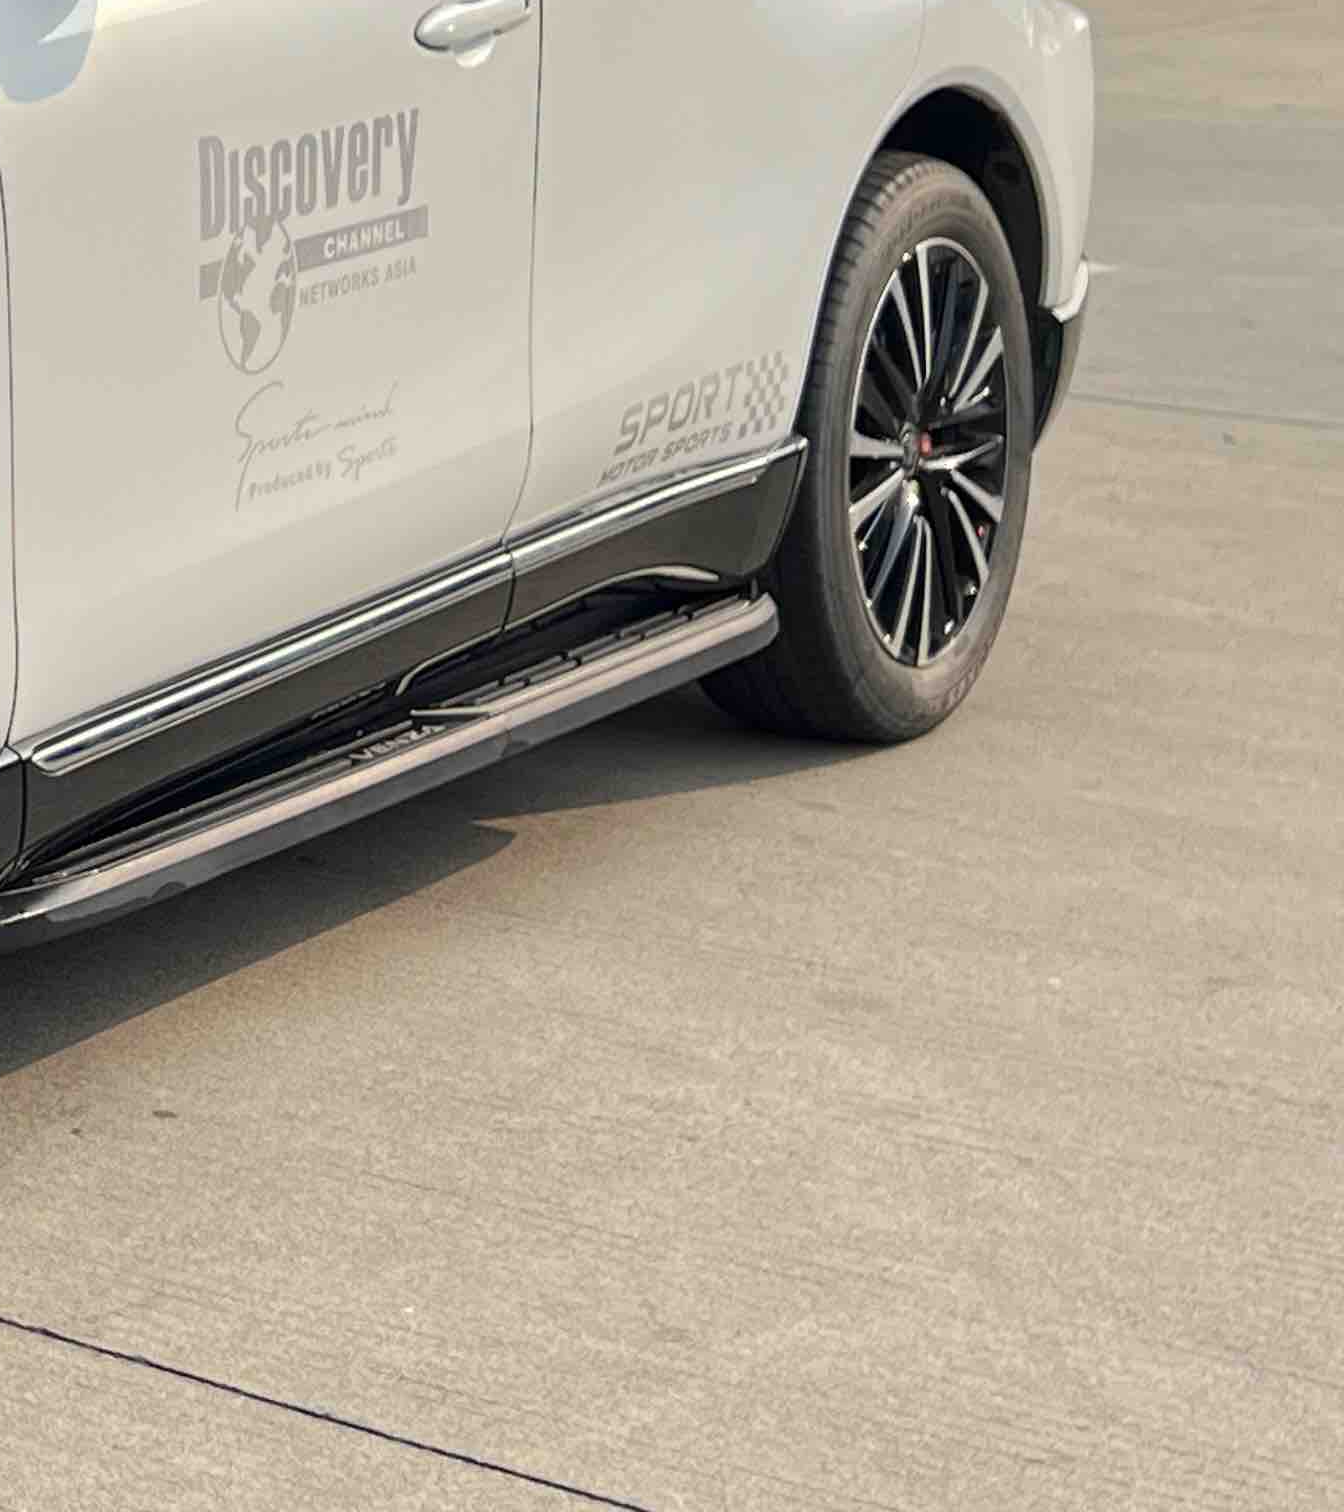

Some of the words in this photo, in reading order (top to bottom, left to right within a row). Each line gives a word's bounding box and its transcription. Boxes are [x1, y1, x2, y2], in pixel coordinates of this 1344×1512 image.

[198, 107, 419, 240] Discovery
[323, 220, 405, 259] CHANNEL
[299, 268, 380, 305] NETWORKS
[384, 256, 417, 284] ASIA
[614, 359, 744, 456] SPORT
[662, 421, 732, 462] SPORTS
